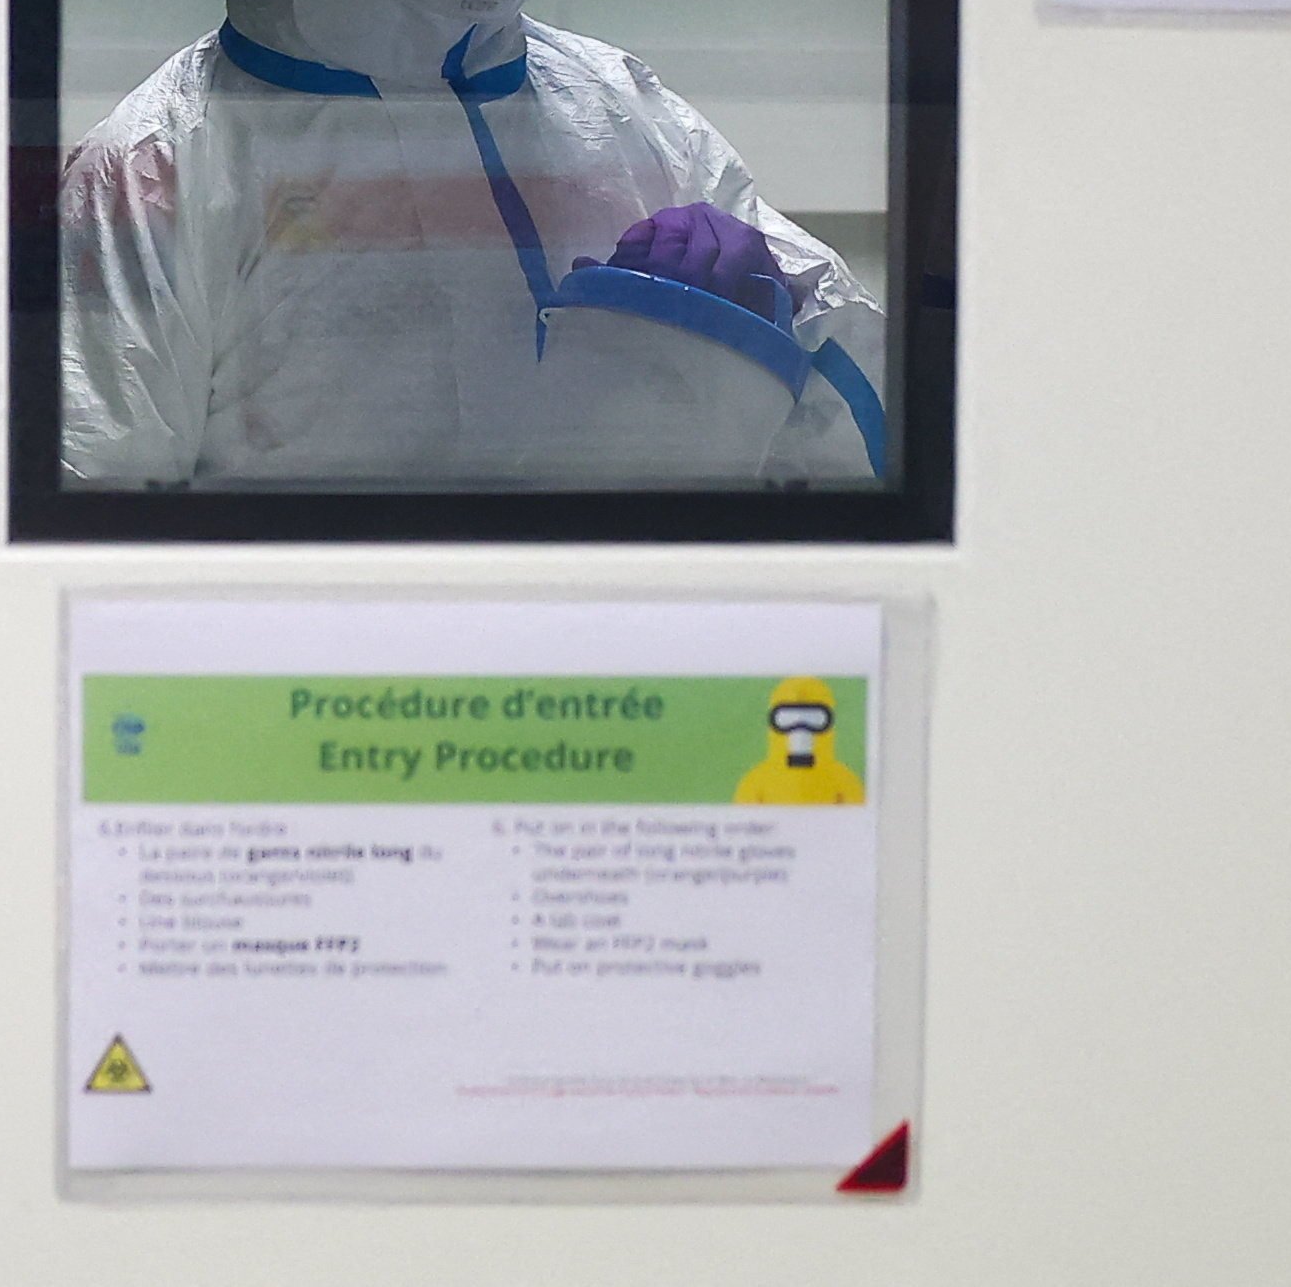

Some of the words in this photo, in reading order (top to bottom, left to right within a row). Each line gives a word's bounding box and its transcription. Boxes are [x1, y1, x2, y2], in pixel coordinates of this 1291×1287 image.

[290, 686, 491, 721] Procédure
[501, 686, 665, 721] d'entrée
[318, 739, 422, 781] Entry
[435, 738, 635, 773] Procedure
[514, 821, 545, 834] Put
[551, 821, 573, 834] on
[579, 821, 597, 834] in
[600, 821, 630, 834] the
[635, 821, 717, 838] following
[246, 845, 301, 863] gants
[305, 845, 364, 859] nitrile
[370, 845, 412, 863] long
[534, 844, 566, 859] The
[570, 844, 607, 863] pair
[611, 844, 631, 859] of
[636, 844, 675, 863] long
[680, 844, 733, 859] nitrile
[737, 844, 796, 863] gloves
[530, 868, 640, 881] underneath
[530, 891, 629, 905] Overshoes
[180, 914, 243, 929] blouse
[531, 914, 546, 928] A
[548, 914, 576, 928] lab
[582, 914, 621, 928] coat
[231, 938, 310, 956] masque
[314, 936, 361, 952] FFP2
[531, 937, 578, 951] Wear
[584, 937, 608, 951] an
[611, 935, 656, 951] FFP2
[660, 937, 708, 951] mask
[530, 960, 563, 974] Put
[566, 960, 591, 974] on
[595, 960, 686, 978] protective
[692, 960, 762, 978] goggles
